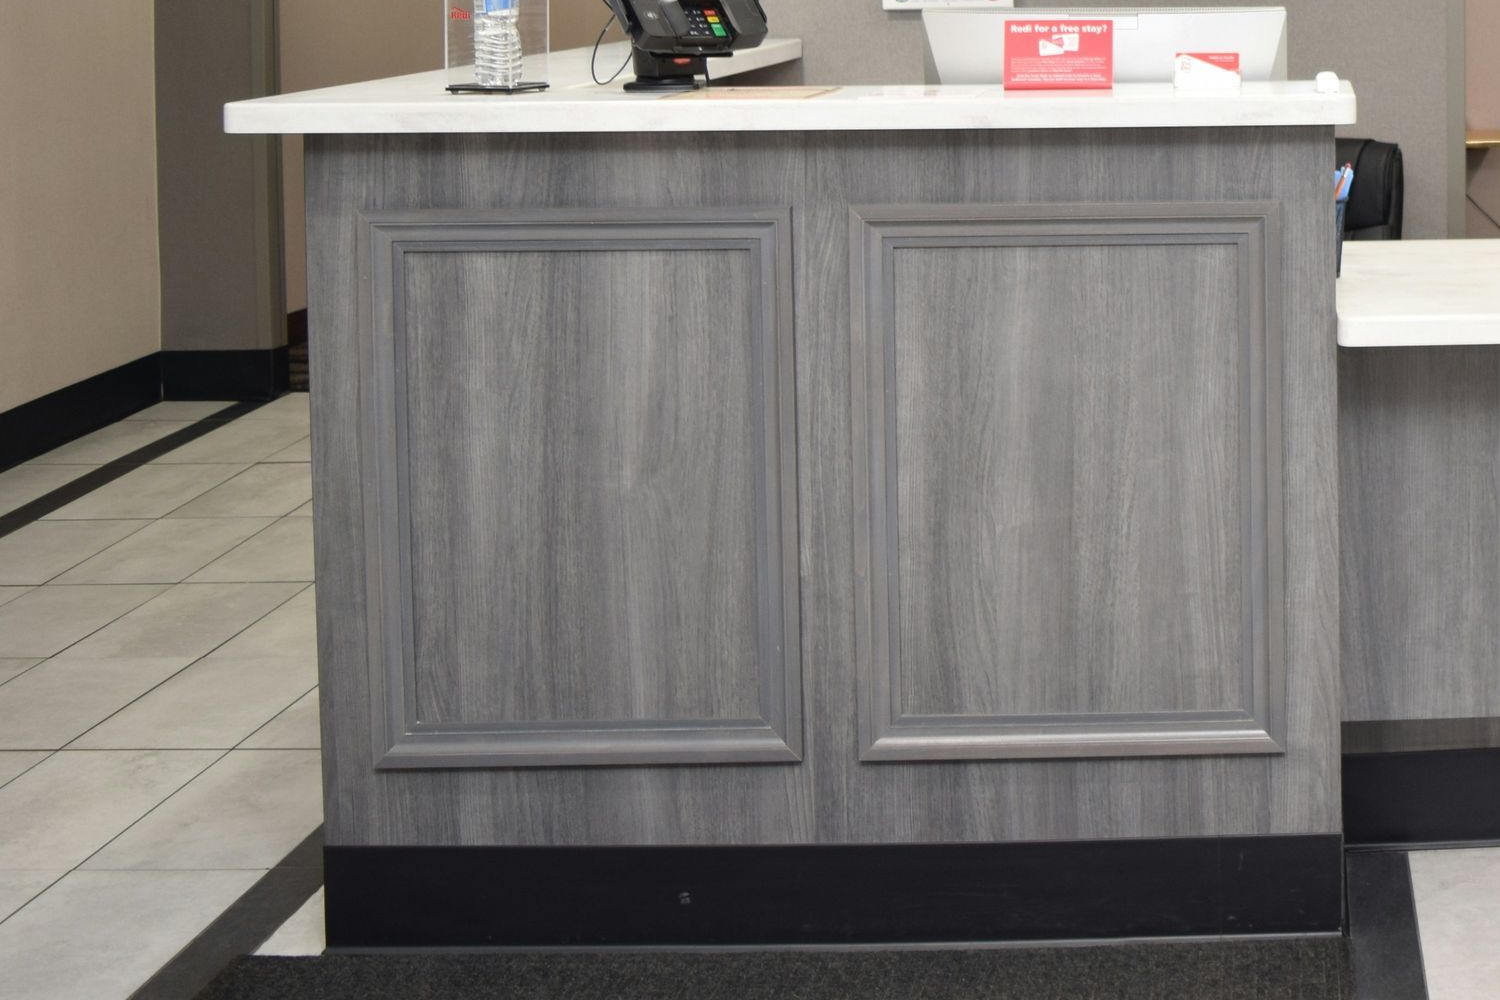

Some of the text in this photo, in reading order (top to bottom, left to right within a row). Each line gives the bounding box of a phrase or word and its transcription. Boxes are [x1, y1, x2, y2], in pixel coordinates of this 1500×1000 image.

[1010, 24, 1108, 35] Redi for a free stay?
